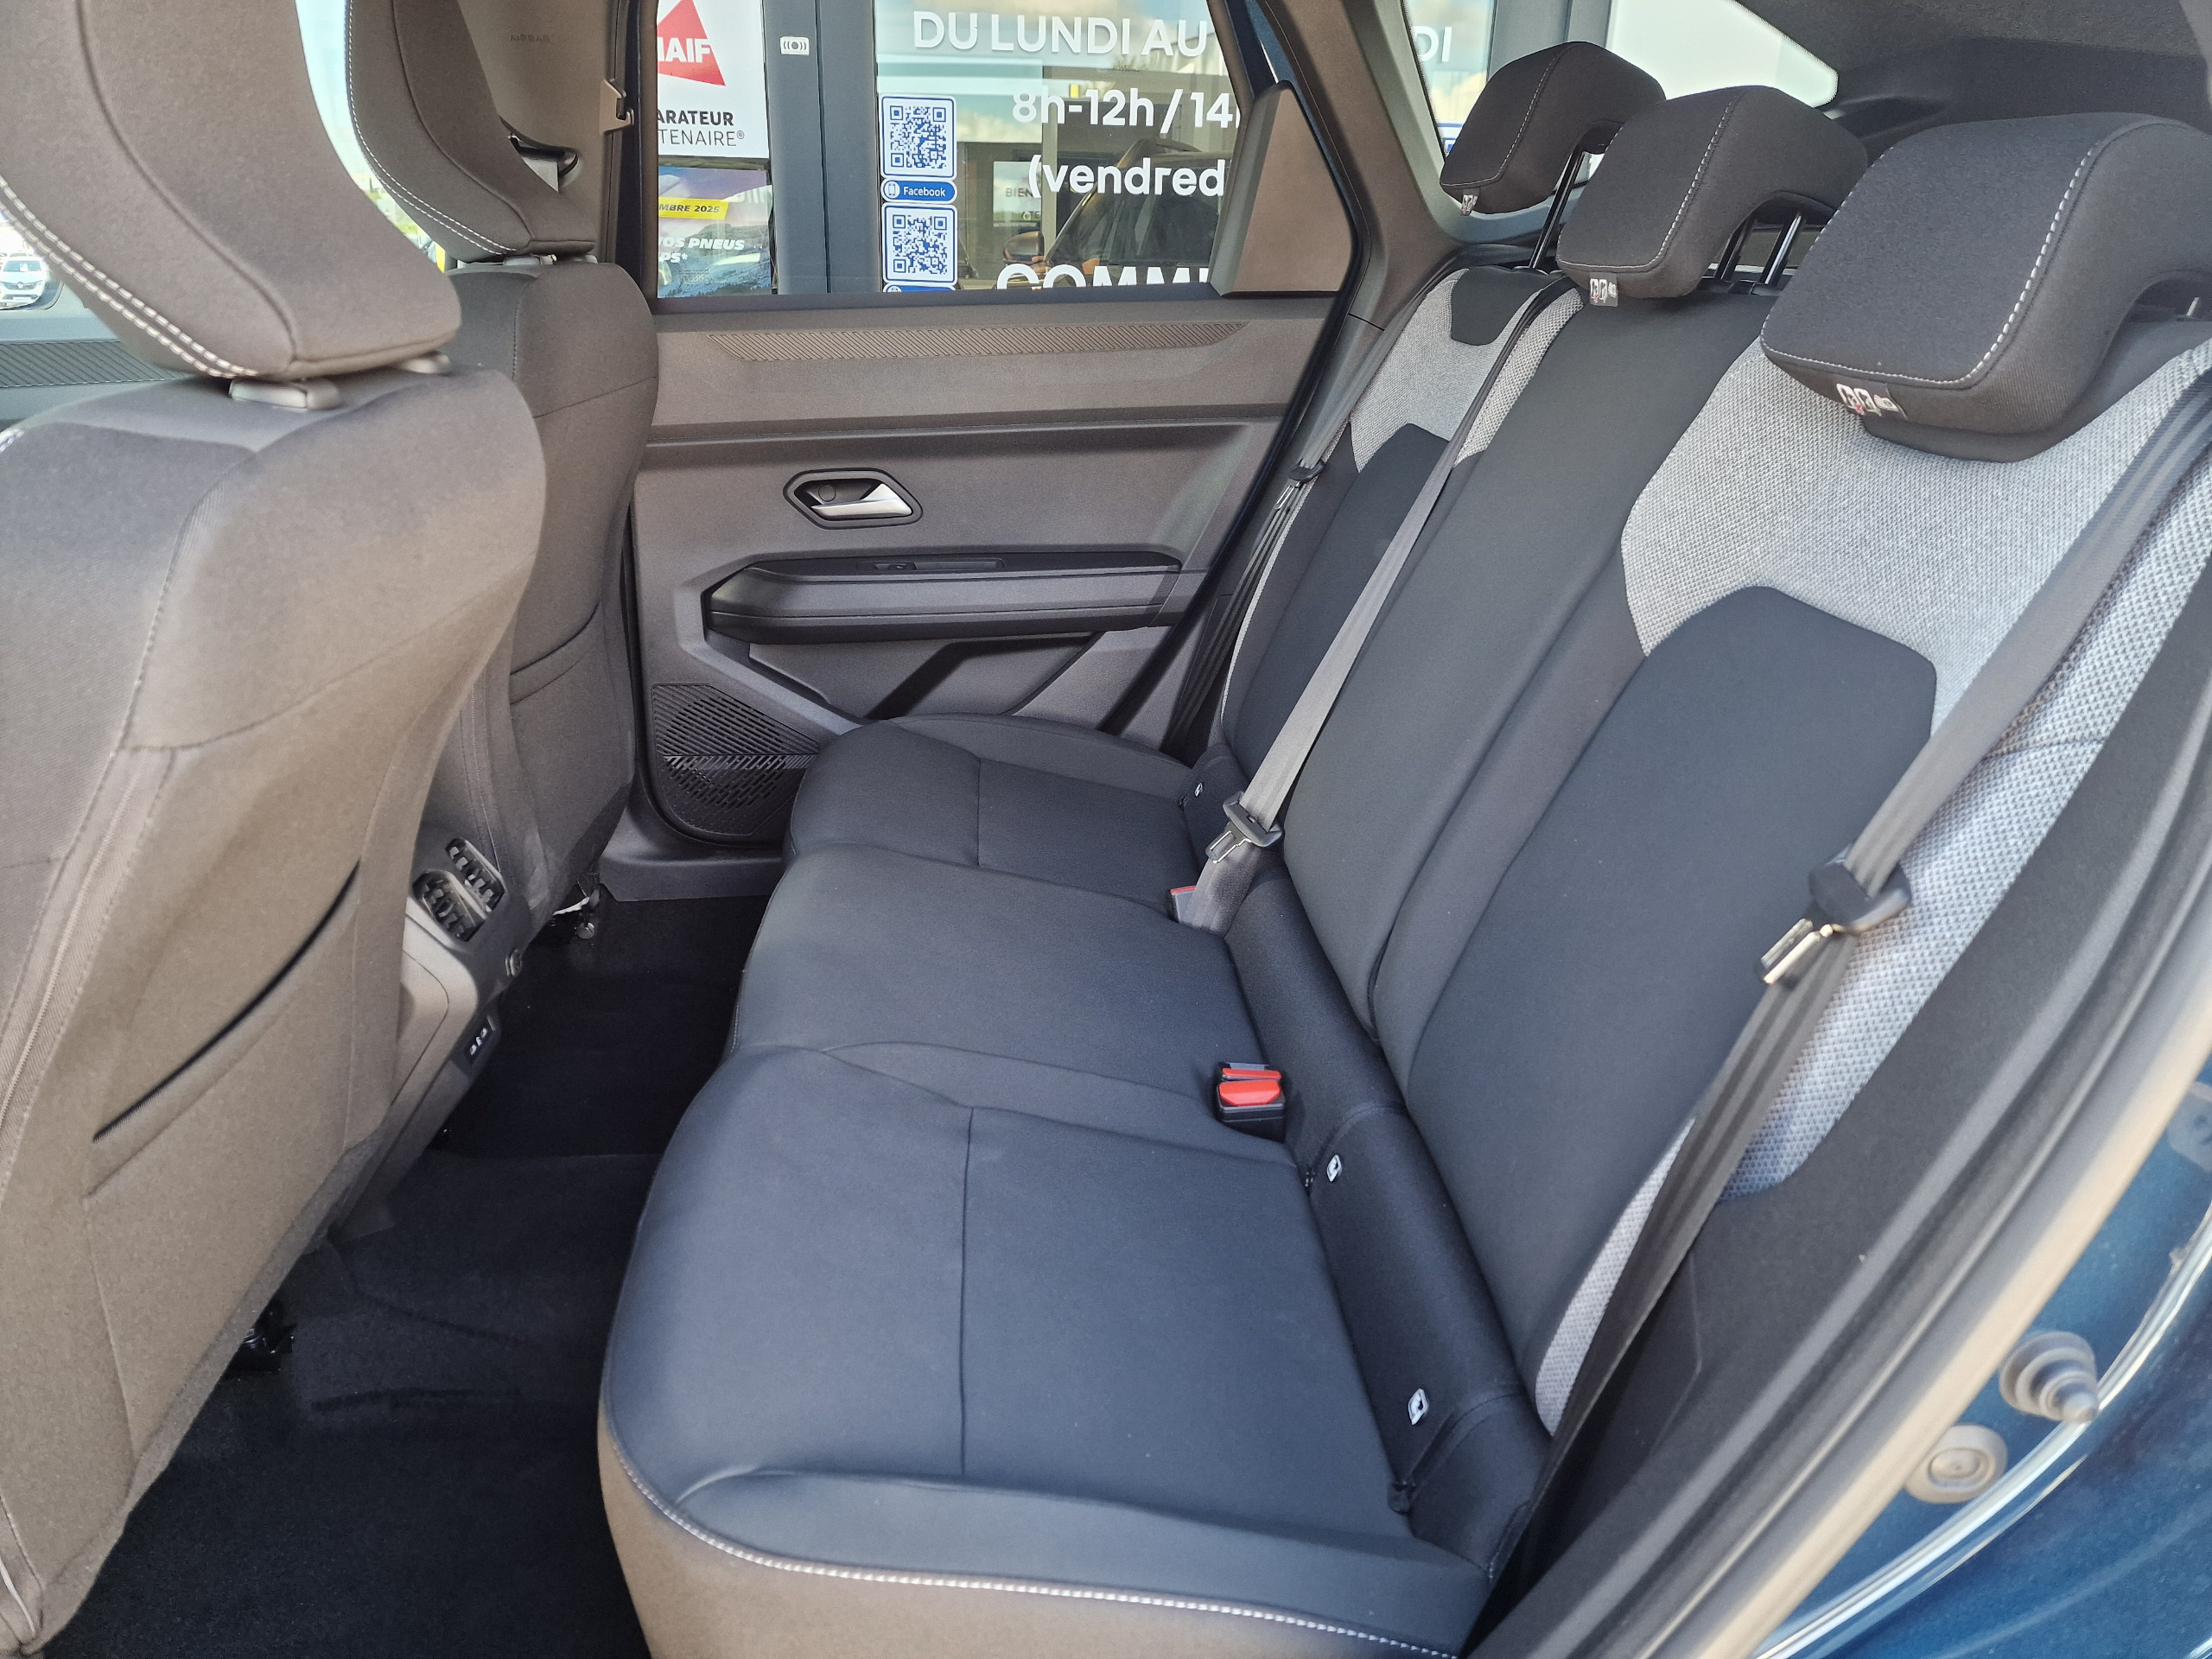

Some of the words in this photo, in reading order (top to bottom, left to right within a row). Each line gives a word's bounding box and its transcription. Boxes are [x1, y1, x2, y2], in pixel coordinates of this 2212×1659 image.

[913, 10, 978, 50] DU
[991, 15, 1130, 54] LUNDI
[1141, 19, 1208, 57] AU
[1012, 88, 1154, 128] 8h-12h
[1028, 154, 1232, 198] (vendred
[903, 186, 946, 197] Facebook
[694, 205, 720, 213] 2025
[688, 238, 745, 251] PNEUS
[996, 264, 1210, 290] COMM
